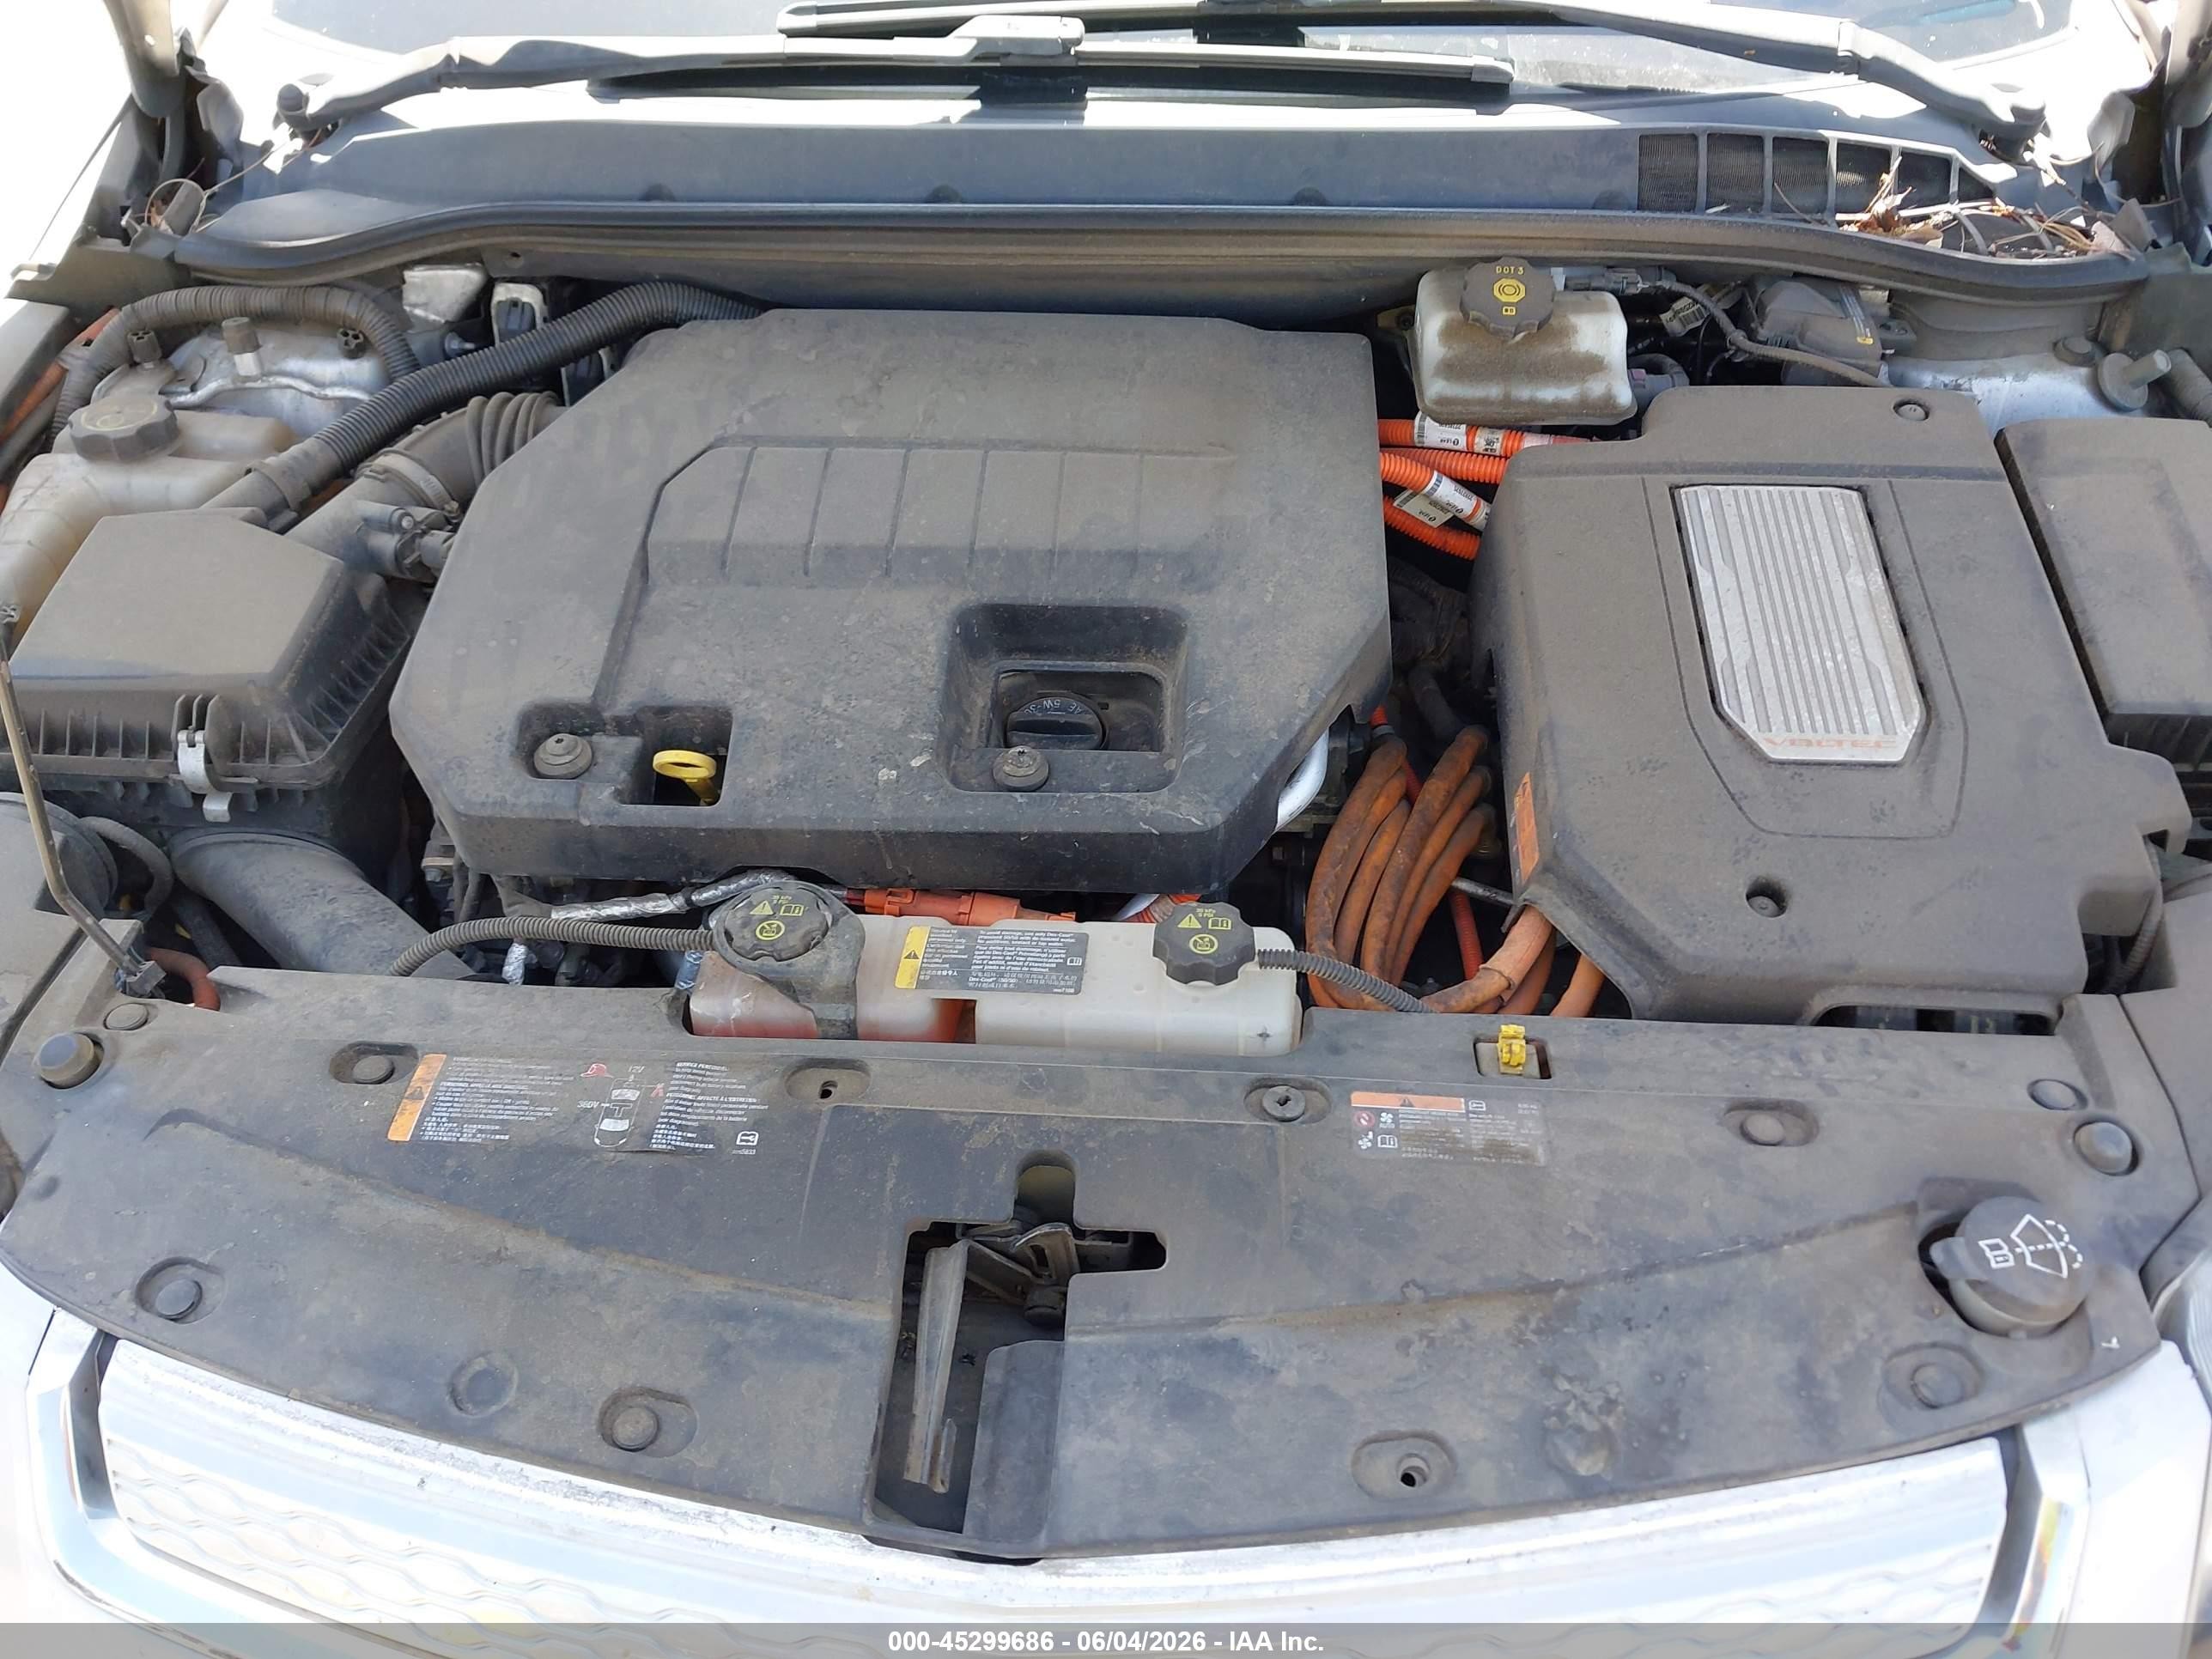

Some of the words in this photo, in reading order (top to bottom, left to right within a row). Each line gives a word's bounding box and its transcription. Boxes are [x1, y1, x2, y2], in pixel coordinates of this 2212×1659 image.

[1496, 266, 1515, 275] DOT
[1517, 266, 1524, 275] 3
[1762, 737, 1896, 750] VOLTEC
